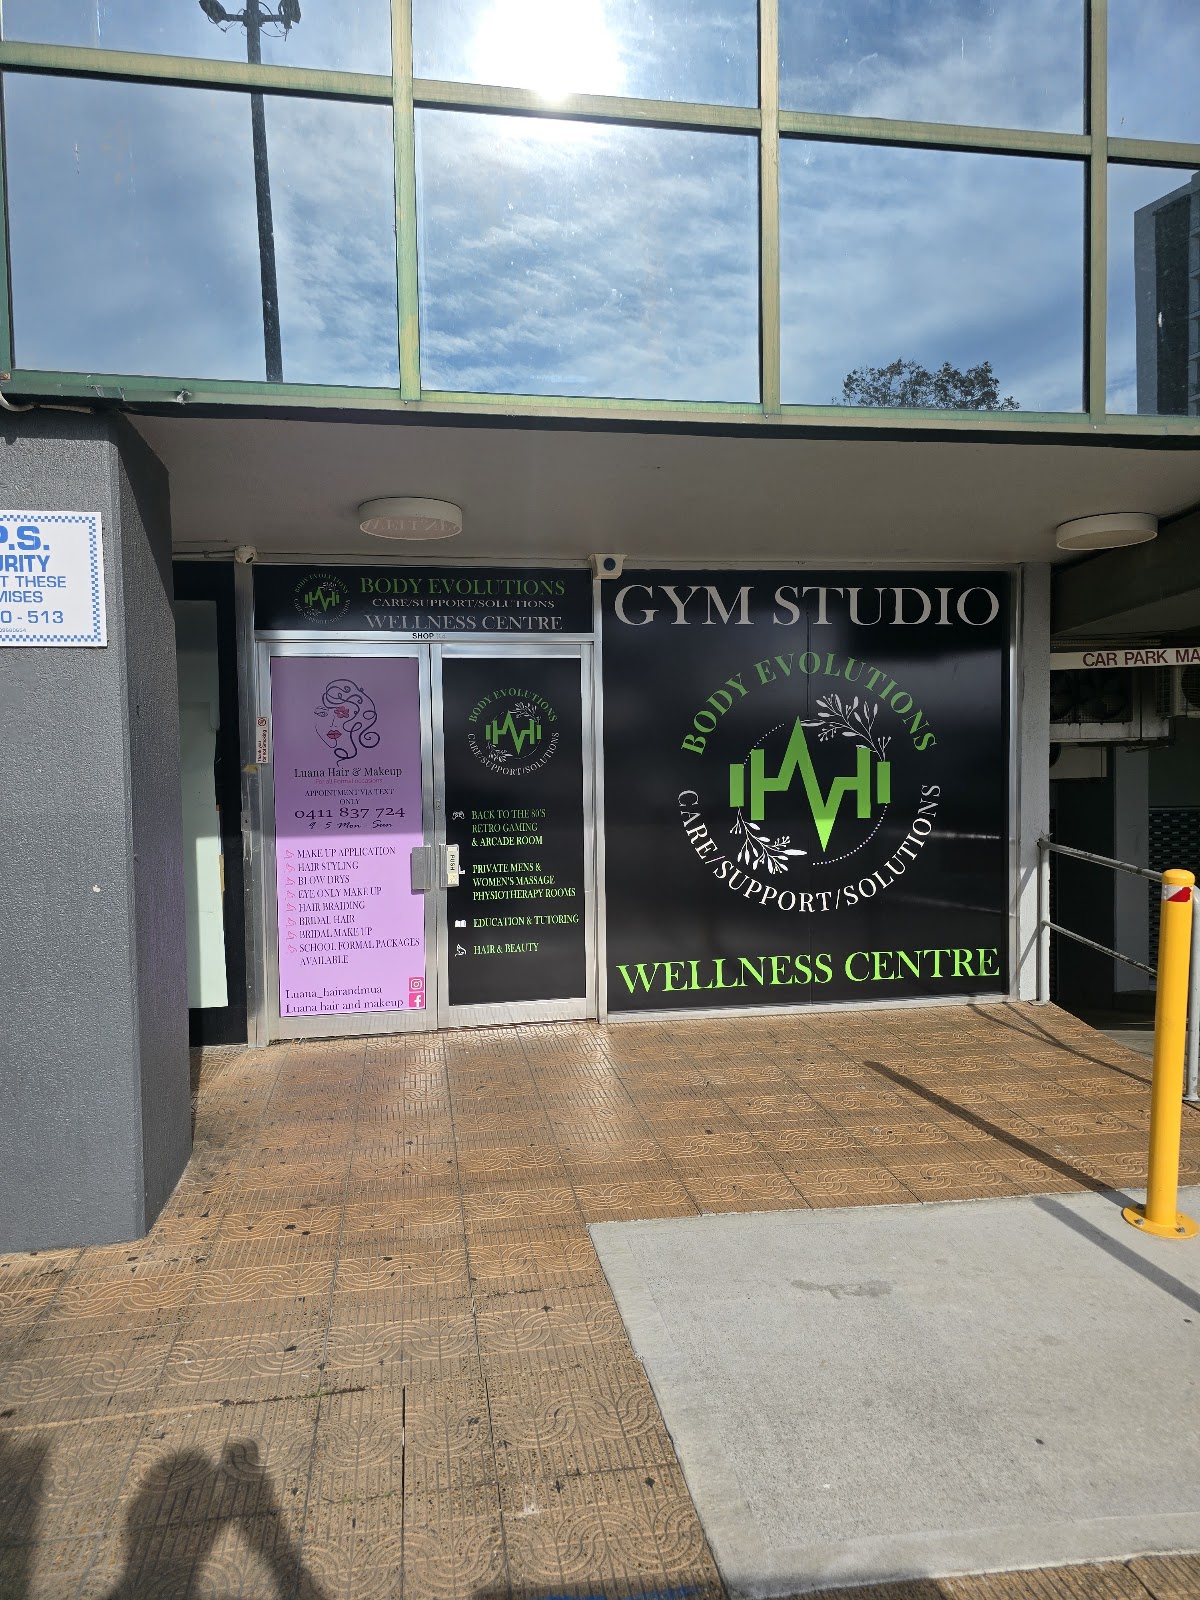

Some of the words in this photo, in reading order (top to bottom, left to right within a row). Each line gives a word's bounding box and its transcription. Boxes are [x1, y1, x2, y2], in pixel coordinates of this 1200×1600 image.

[15, 576, 66, 588] THESE
[360, 577, 422, 594] BODY
[428, 578, 565, 595] EVOLUTIONS
[372, 598, 555, 609] CARE/SUPPORT/SOLUTIONS
[614, 584, 755, 626] GYM
[773, 585, 1000, 626] STUDIO
[27, 610, 64, 624] 513
[364, 614, 477, 630] WELLNESS
[481, 615, 563, 630] CENTRE
[1082, 652, 1117, 667] CAR
[1124, 650, 1168, 665] PARK
[468, 695, 492, 722] BODY
[493, 687, 558, 722] EVOLUTIONS
[681, 672, 749, 755] BODY
[753, 651, 937, 751] EVOLUTIONS
[294, 768, 325, 778] Luana
[328, 767, 350, 777] Hair
[352, 767, 361, 777] &
[364, 766, 403, 778] Makeup
[304, 789, 360, 797] APPOINTMENT
[294, 809, 333, 820] 0411
[339, 807, 370, 819] 837
[375, 807, 405, 819] 724
[472, 810, 495, 820] BACK
[497, 810, 510, 819] TO
[511, 809, 530, 819] THE
[336, 821, 361, 829] Mon
[472, 823, 500, 833] RETRO
[502, 822, 538, 832] GAMING
[471, 837, 479, 847] &
[480, 836, 515, 847] ARCADE
[516, 835, 543, 846] ROOM
[297, 848, 323, 859] MAKE
[324, 848, 337, 858] UP
[338, 846, 396, 857] APPLICATION
[678, 784, 941, 913] CARE/SUPPORT/SOLUTIONS
[298, 862, 320, 872] HAIR
[321, 861, 360, 871] STYLING
[472, 863, 509, 874] PRIVATE
[510, 863, 534, 873] MENS
[535, 862, 542, 872] &
[298, 875, 325, 886] BLOW
[327, 874, 350, 885] DRYS
[473, 877, 515, 887] WOMEN'S
[516, 875, 556, 886] MASSAGE
[298, 889, 316, 899] EYE
[316, 888, 342, 898] ONLY
[343, 887, 368, 897] MAKE
[370, 886, 382, 896] UP
[473, 888, 544, 901] PHYSIOTHERAPY
[545, 887, 576, 898] ROOMS
[299, 902, 321, 913] HAIR
[322, 900, 365, 912] BRAIDING
[299, 916, 332, 926] BRIDAL
[333, 914, 356, 924] HAIR
[473, 916, 525, 928] EDUCATION
[526, 916, 533, 925] &
[534, 914, 580, 925] TUTORING
[299, 929, 333, 939] BRIDAL
[333, 927, 360, 938] MAKE
[361, 926, 373, 936] UP
[299, 942, 337, 953] SCHOOL
[338, 940, 375, 951] FORMAL
[375, 937, 420, 949] PACKAGES
[473, 945, 496, 955] HAIR
[496, 944, 503, 954] &
[505, 942, 539, 953] BEAUTY
[300, 955, 349, 966] AVAILABLE
[616, 953, 833, 994] WELLNESS
[845, 948, 1000, 982] CENTRE
[286, 1003, 317, 1014] Luana
[320, 1001, 340, 1011] hair
[342, 1000, 361, 1010] and
[364, 998, 404, 1009] makeup
